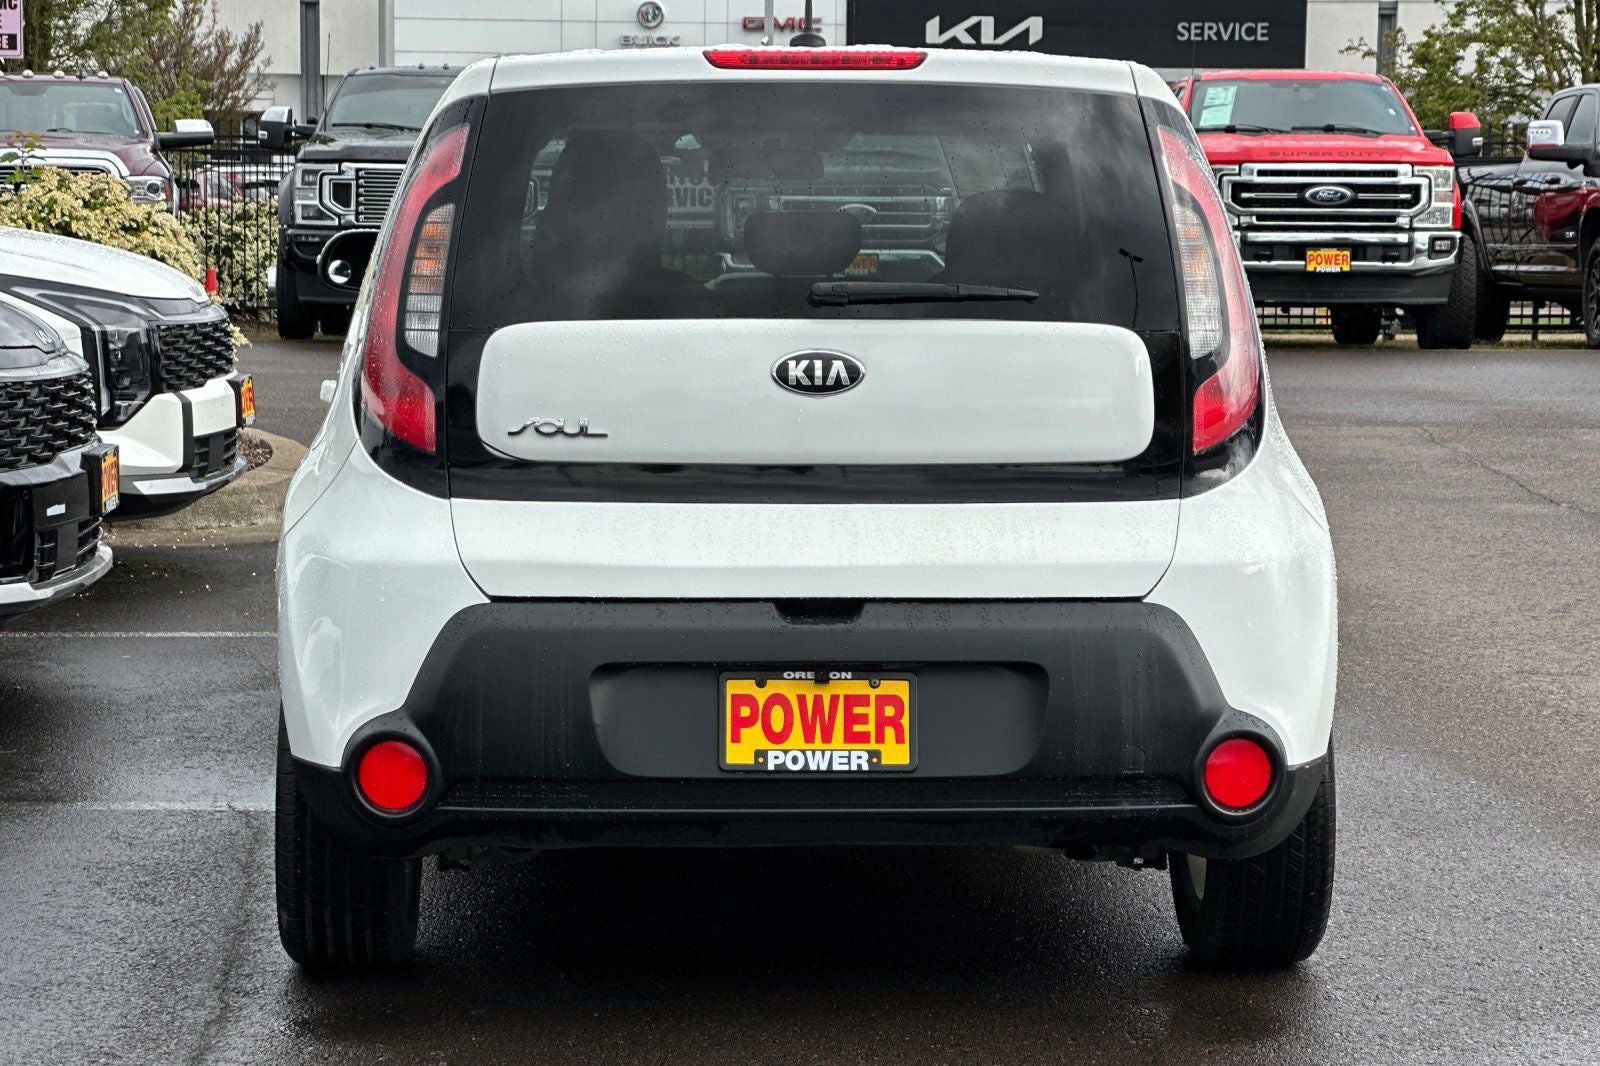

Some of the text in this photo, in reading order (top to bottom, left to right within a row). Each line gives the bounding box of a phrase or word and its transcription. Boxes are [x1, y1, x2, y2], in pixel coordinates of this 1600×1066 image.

[620, 34, 680, 47] BUICK
[925, 14, 1043, 46] KIA
[1176, 21, 1269, 42] SERVICE
[1316, 190, 1341, 201] Ford
[1308, 253, 1349, 266] POWER
[787, 359, 851, 386] KIA
[507, 416, 609, 438] SOUL
[783, 671, 852, 680] OREON
[730, 692, 906, 745] POWER
[767, 750, 870, 771] POWER
